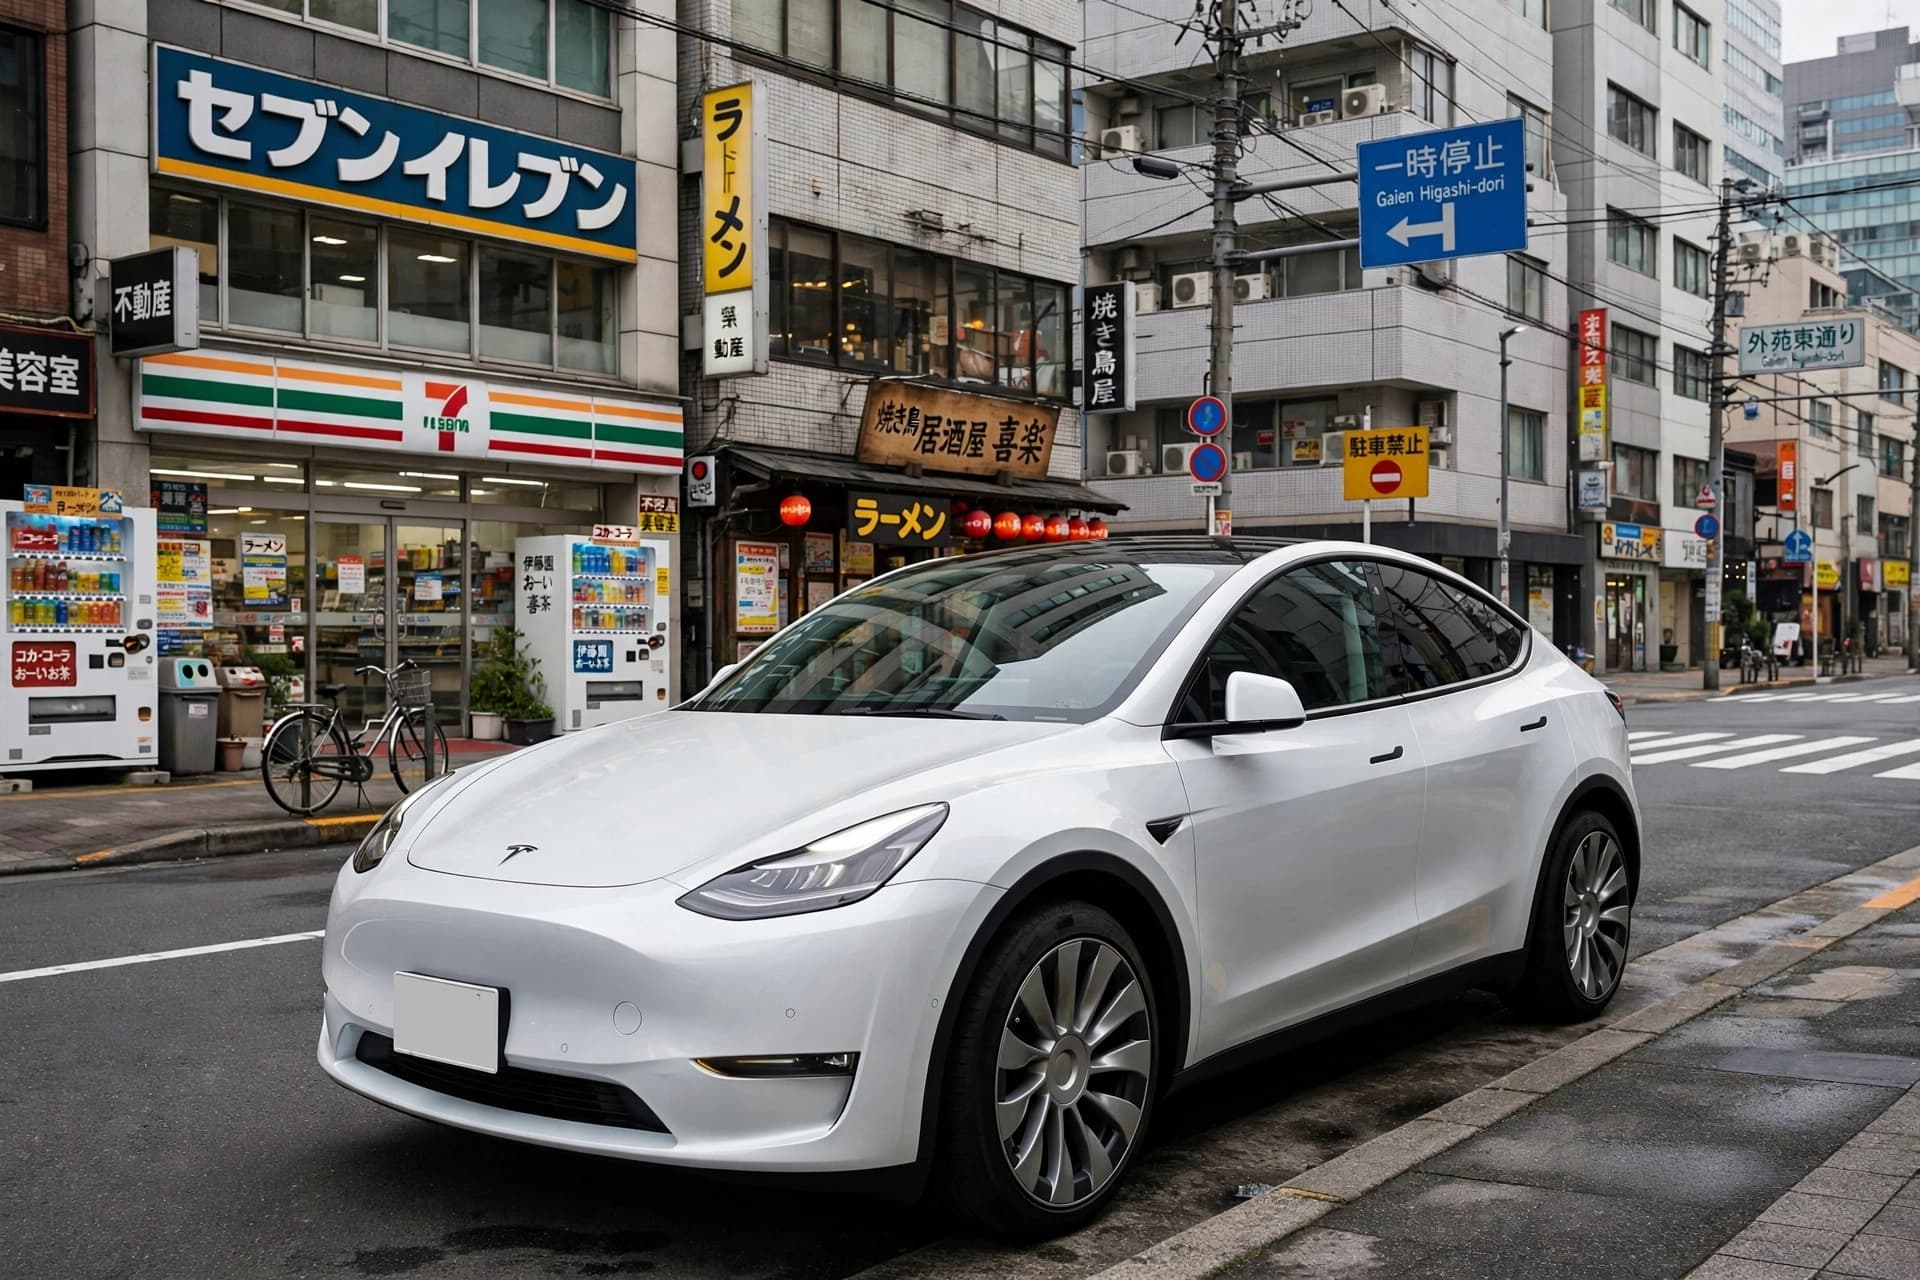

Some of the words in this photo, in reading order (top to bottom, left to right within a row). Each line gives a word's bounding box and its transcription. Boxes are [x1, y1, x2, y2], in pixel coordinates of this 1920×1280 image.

[177, 69, 628, 231] セブンイレブン
[1375, 134, 1505, 179] 一時停止
[1376, 188, 1414, 207] Gaien
[1420, 174, 1505, 203] Higashi-dori
[114, 279, 171, 323] 不動産
[1091, 291, 1117, 405] 焼き鳥屋
[1748, 323, 1854, 354] 外苑東通り
[874, 400, 920, 437] 焼き鳥
[914, 414, 988, 458] 居酒屋
[992, 415, 1047, 464] 喜楽
[1350, 432, 1424, 458] 駐車禁止
[854, 498, 946, 540] ラーメン
[244, 540, 283, 552] ラーメン
[523, 575, 553, 591] おーい
[15, 649, 71, 663] コカ・コーラ
[15, 666, 71, 681] おーいお茶
